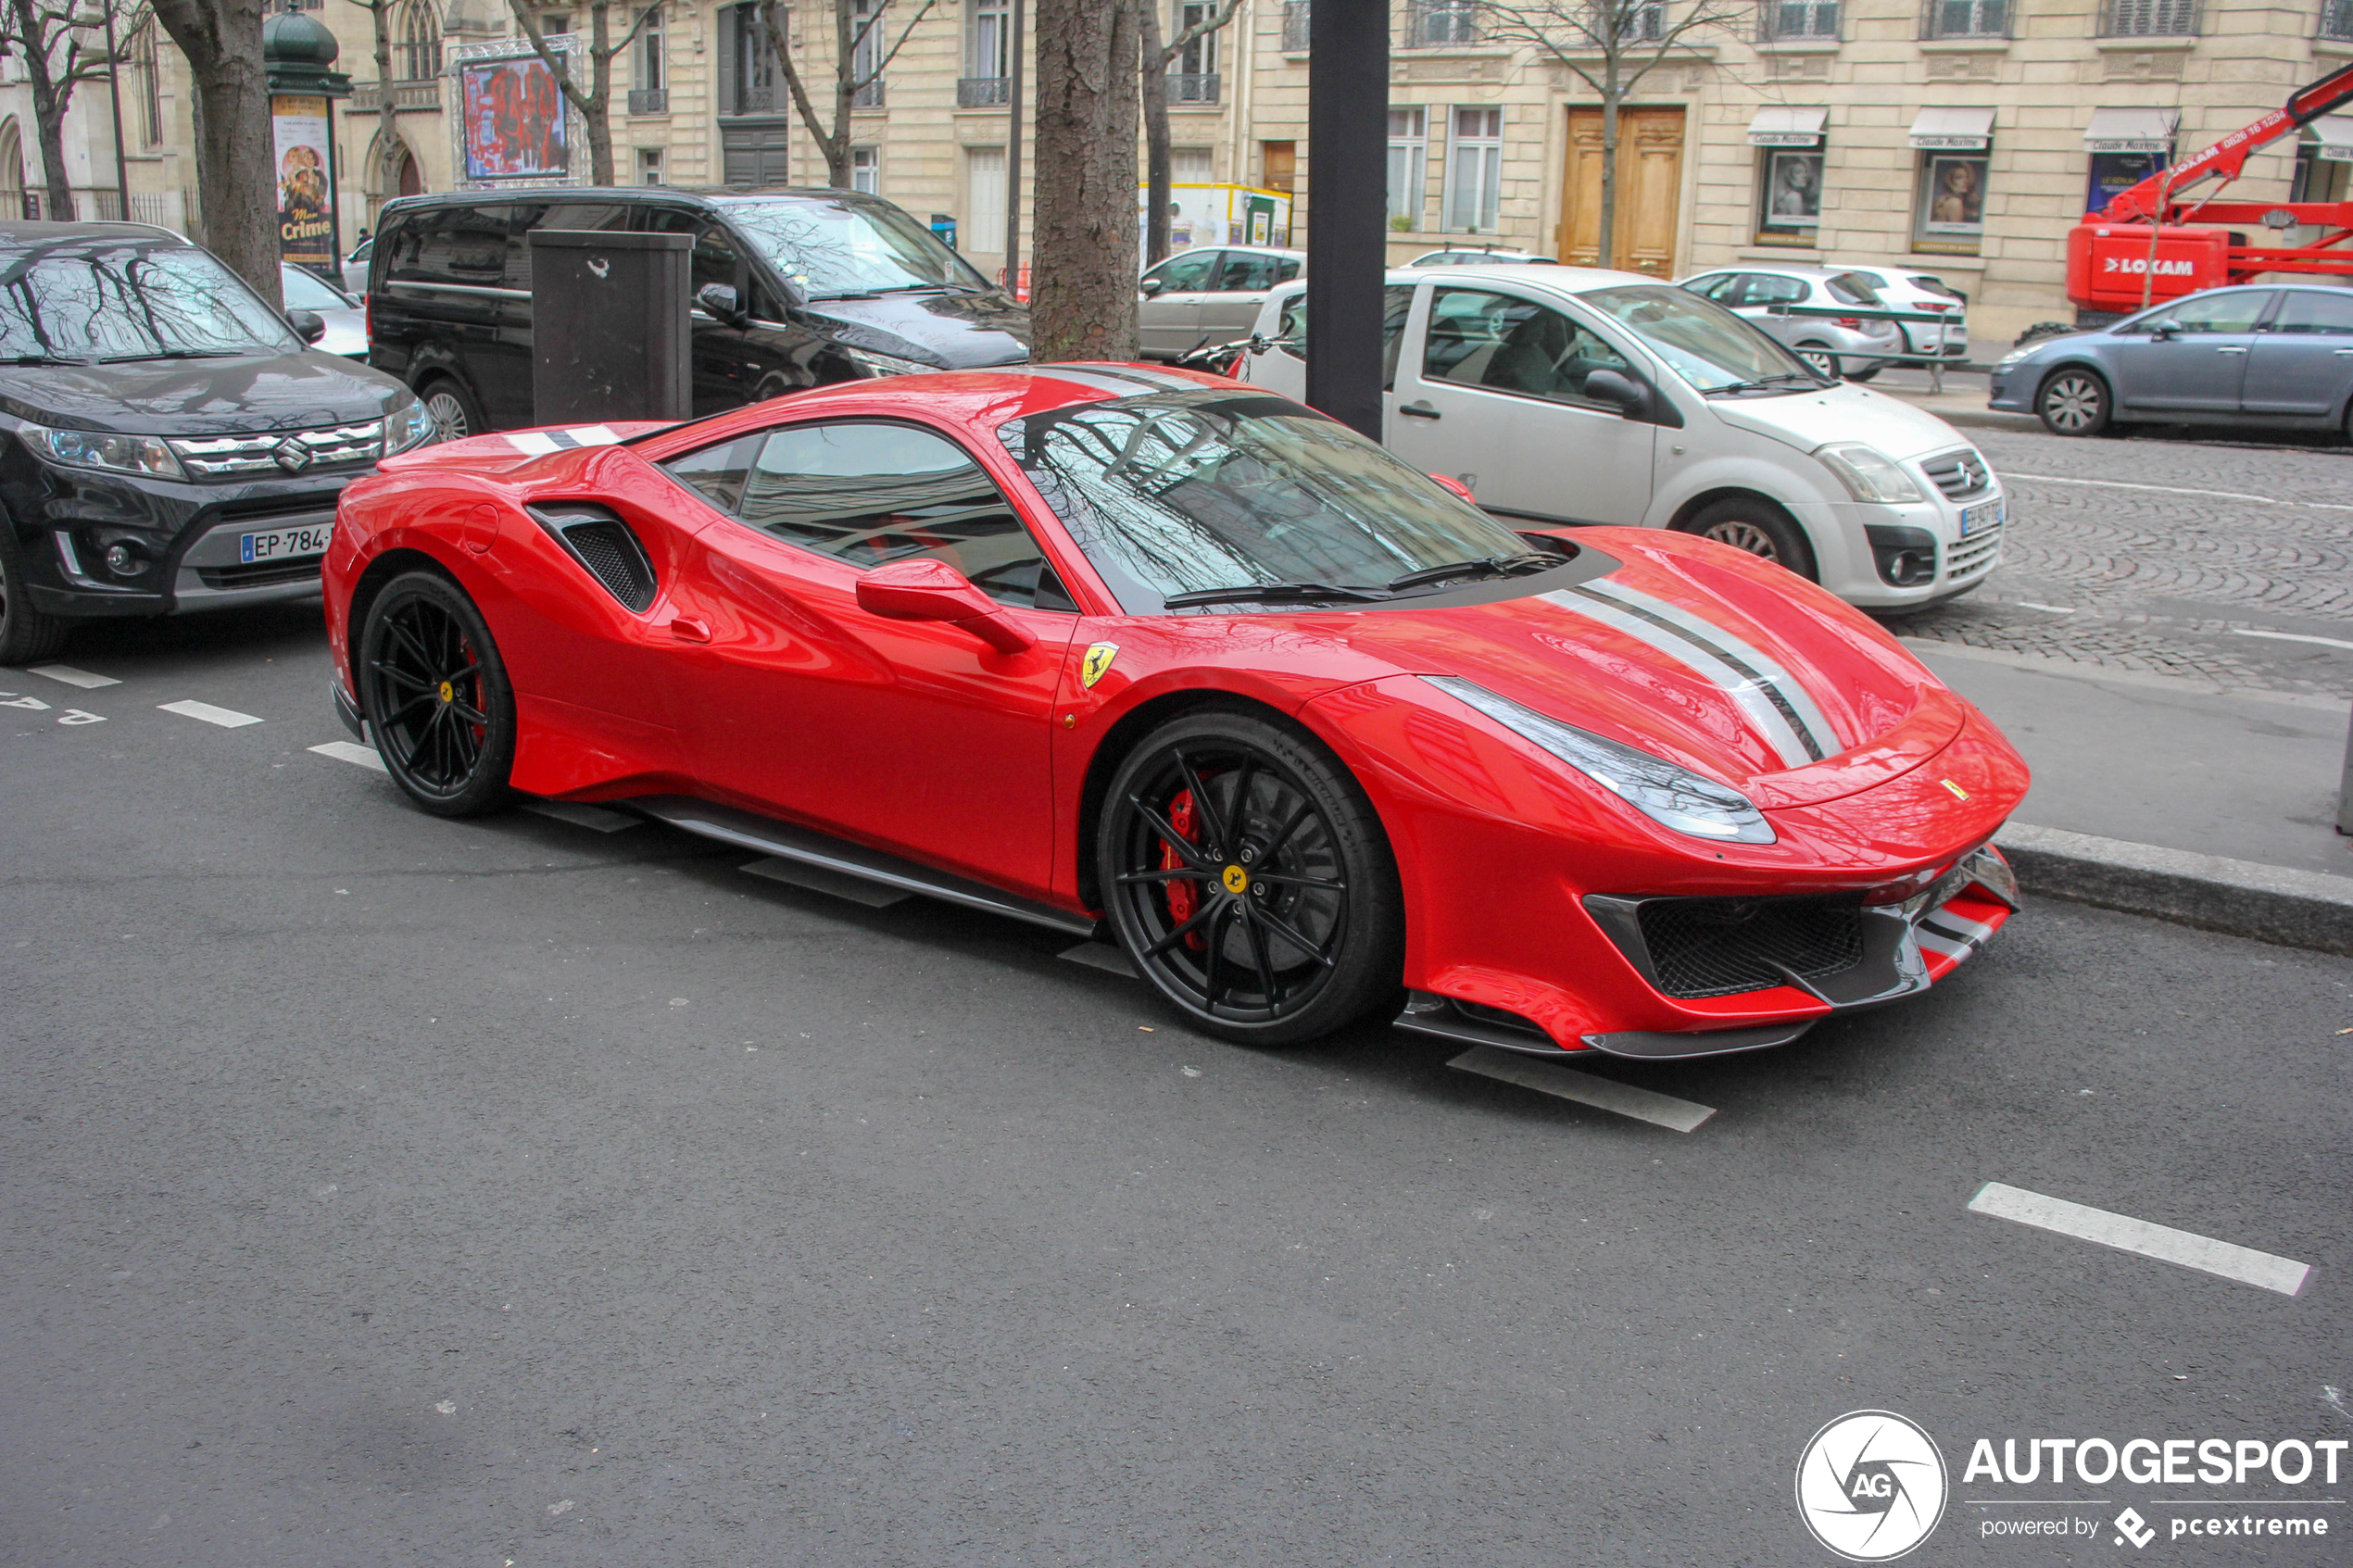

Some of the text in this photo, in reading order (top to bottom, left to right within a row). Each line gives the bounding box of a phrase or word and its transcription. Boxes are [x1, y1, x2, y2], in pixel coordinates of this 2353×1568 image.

[2223, 132, 2247, 149] 0826
[2248, 123, 2261, 135] 16
[2262, 110, 2286, 128] 1234
[1755, 134, 1811, 144] Claude Maxime
[1917, 136, 1978, 146] Claude Maxime
[2094, 140, 2160, 150] Claude Maxime
[291, 208, 318, 220] Mon
[282, 220, 331, 240] Crime
[2121, 258, 2193, 276] LOXAM
[255, 527, 334, 557] EP-784-
